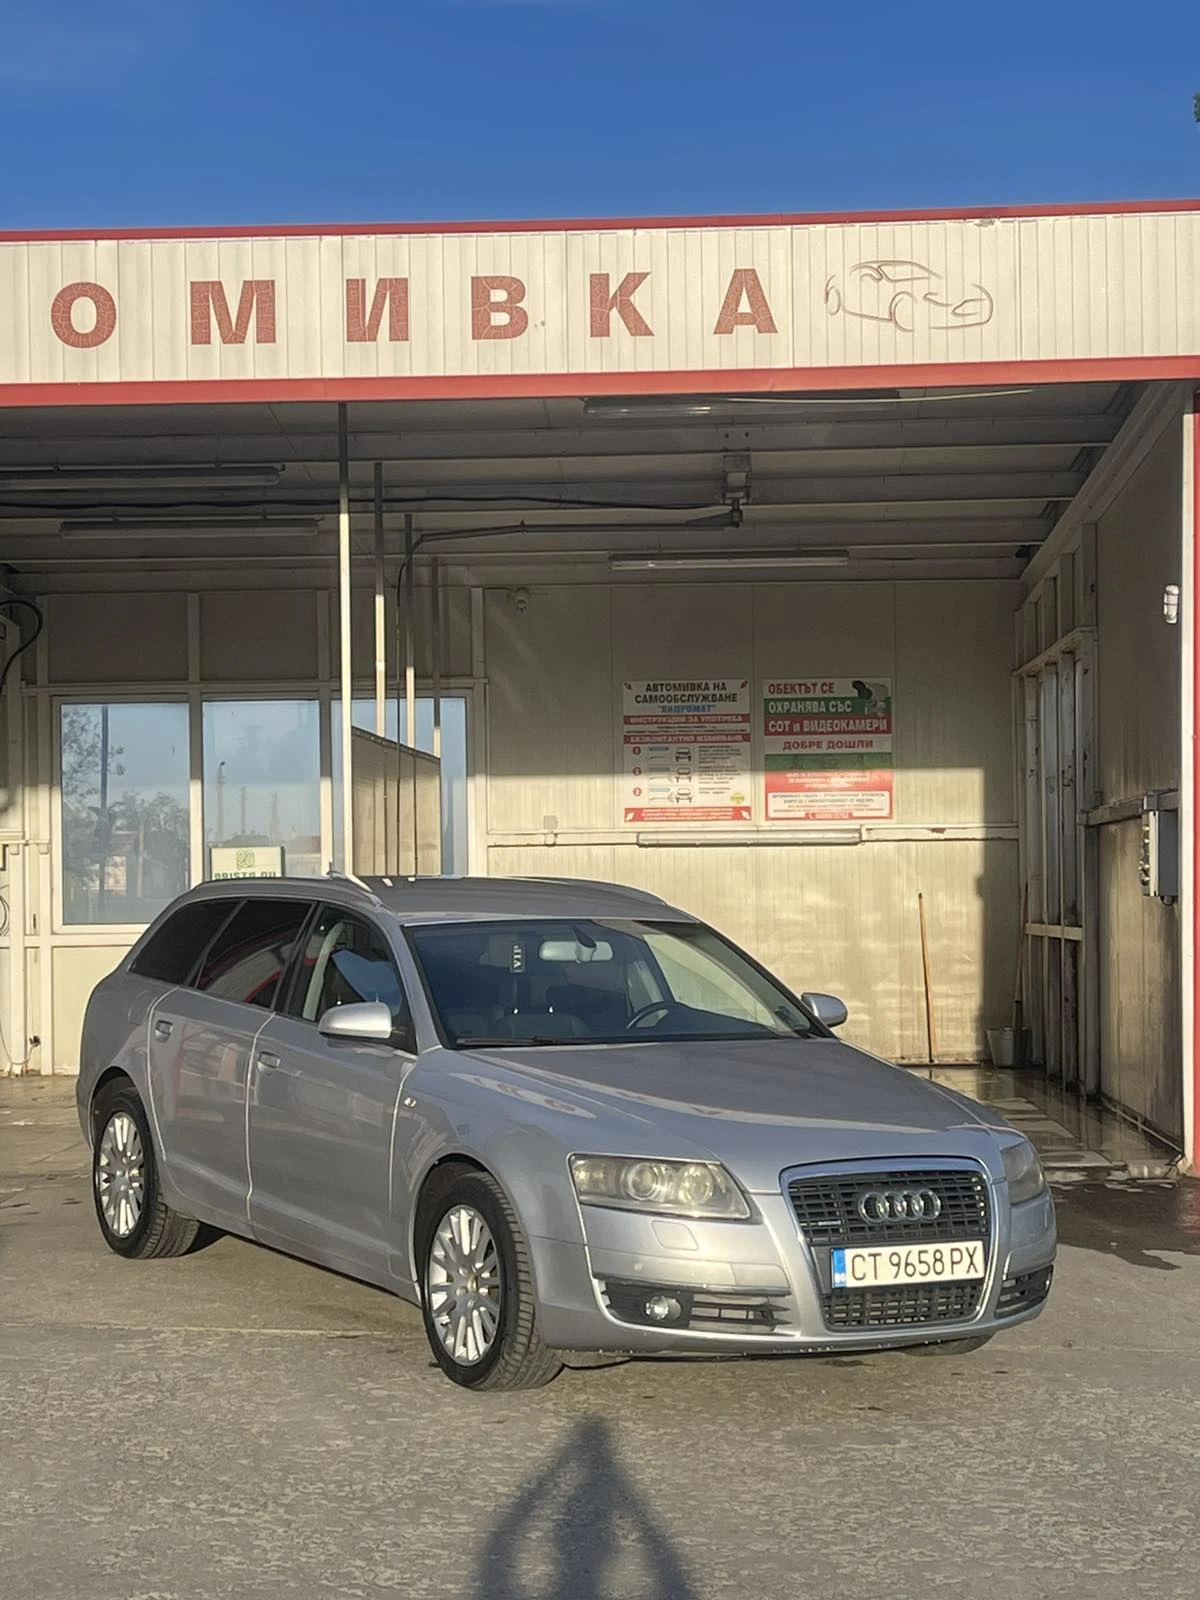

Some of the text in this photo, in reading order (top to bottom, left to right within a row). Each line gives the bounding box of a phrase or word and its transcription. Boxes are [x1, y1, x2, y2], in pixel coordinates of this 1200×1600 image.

[645, 681, 727, 692] АВТОМИВКА НА
[768, 682, 835, 694] ОБЕКТЪТ СЕ
[634, 692, 738, 704] САМООБСЛУЖВАНЕ
[768, 700, 852, 713] ОХРАНЯВА СЪС
[768, 719, 887, 733] СОТ и ВИДЕОКАМЕРИ
[782, 739, 874, 751] ДОБРЕ ДОШЛИ
[513, 945, 522, 968] VIP
[851, 1246, 979, 1281] CT 9658 PX
